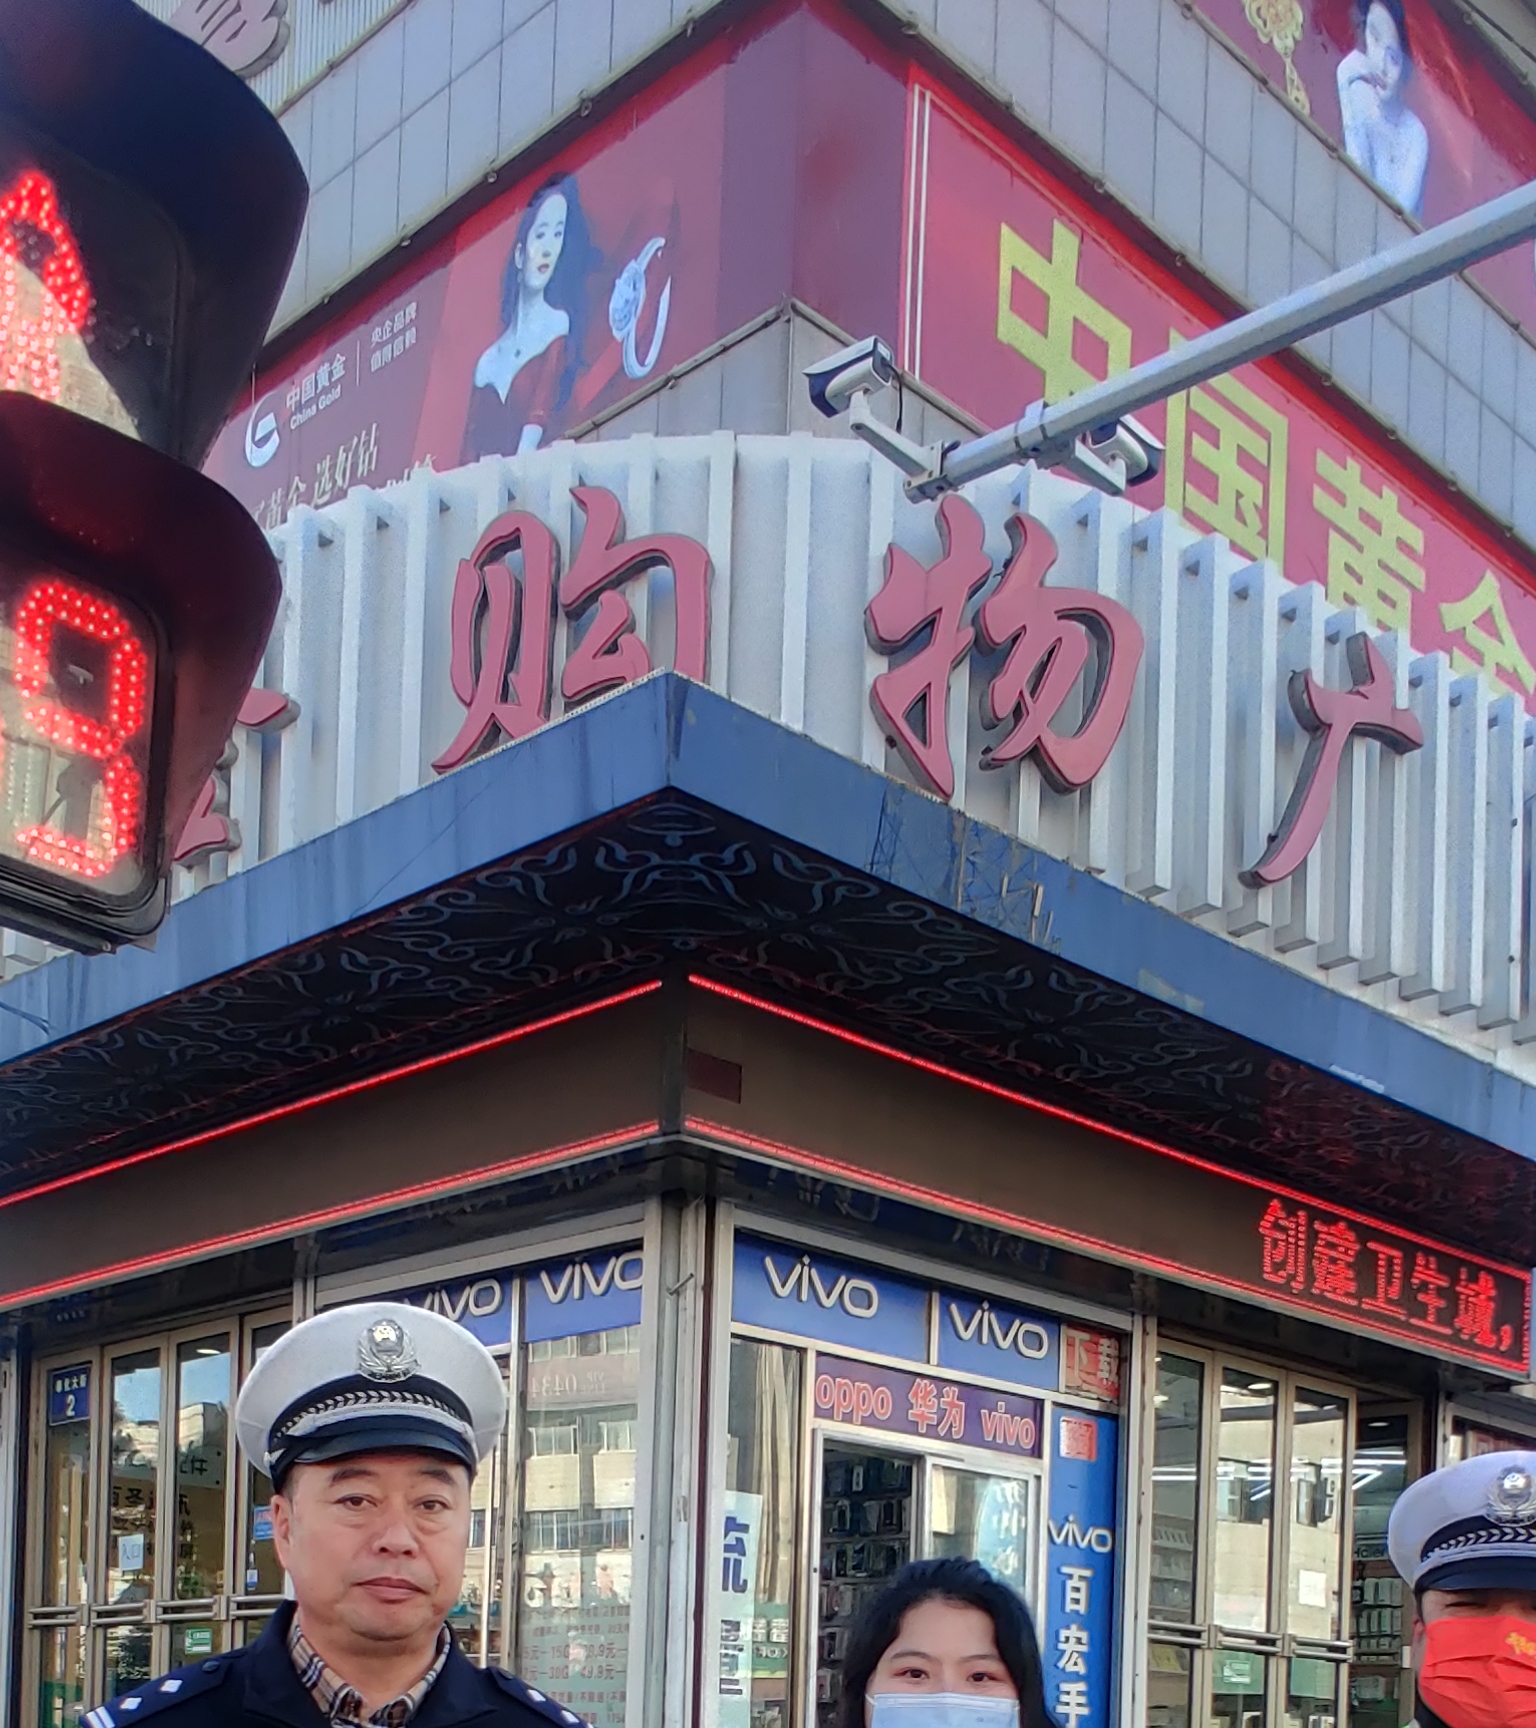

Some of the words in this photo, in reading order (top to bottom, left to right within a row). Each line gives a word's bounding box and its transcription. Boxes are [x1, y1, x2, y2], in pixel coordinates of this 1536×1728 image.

[286, 352, 346, 412] 中国黄金
[290, 402, 316, 430] China
[319, 384, 342, 411] Gold
[540, 1250, 645, 1304] vivo
[765, 1254, 879, 1318] vivo
[950, 1299, 1049, 1359] vivo
[65, 1394, 76, 1417] 2
[815, 1374, 893, 1424] oppo
[908, 1377, 964, 1440] 华为
[980, 1402, 1036, 1449] vivo
[1048, 1513, 1113, 1554] vivo
